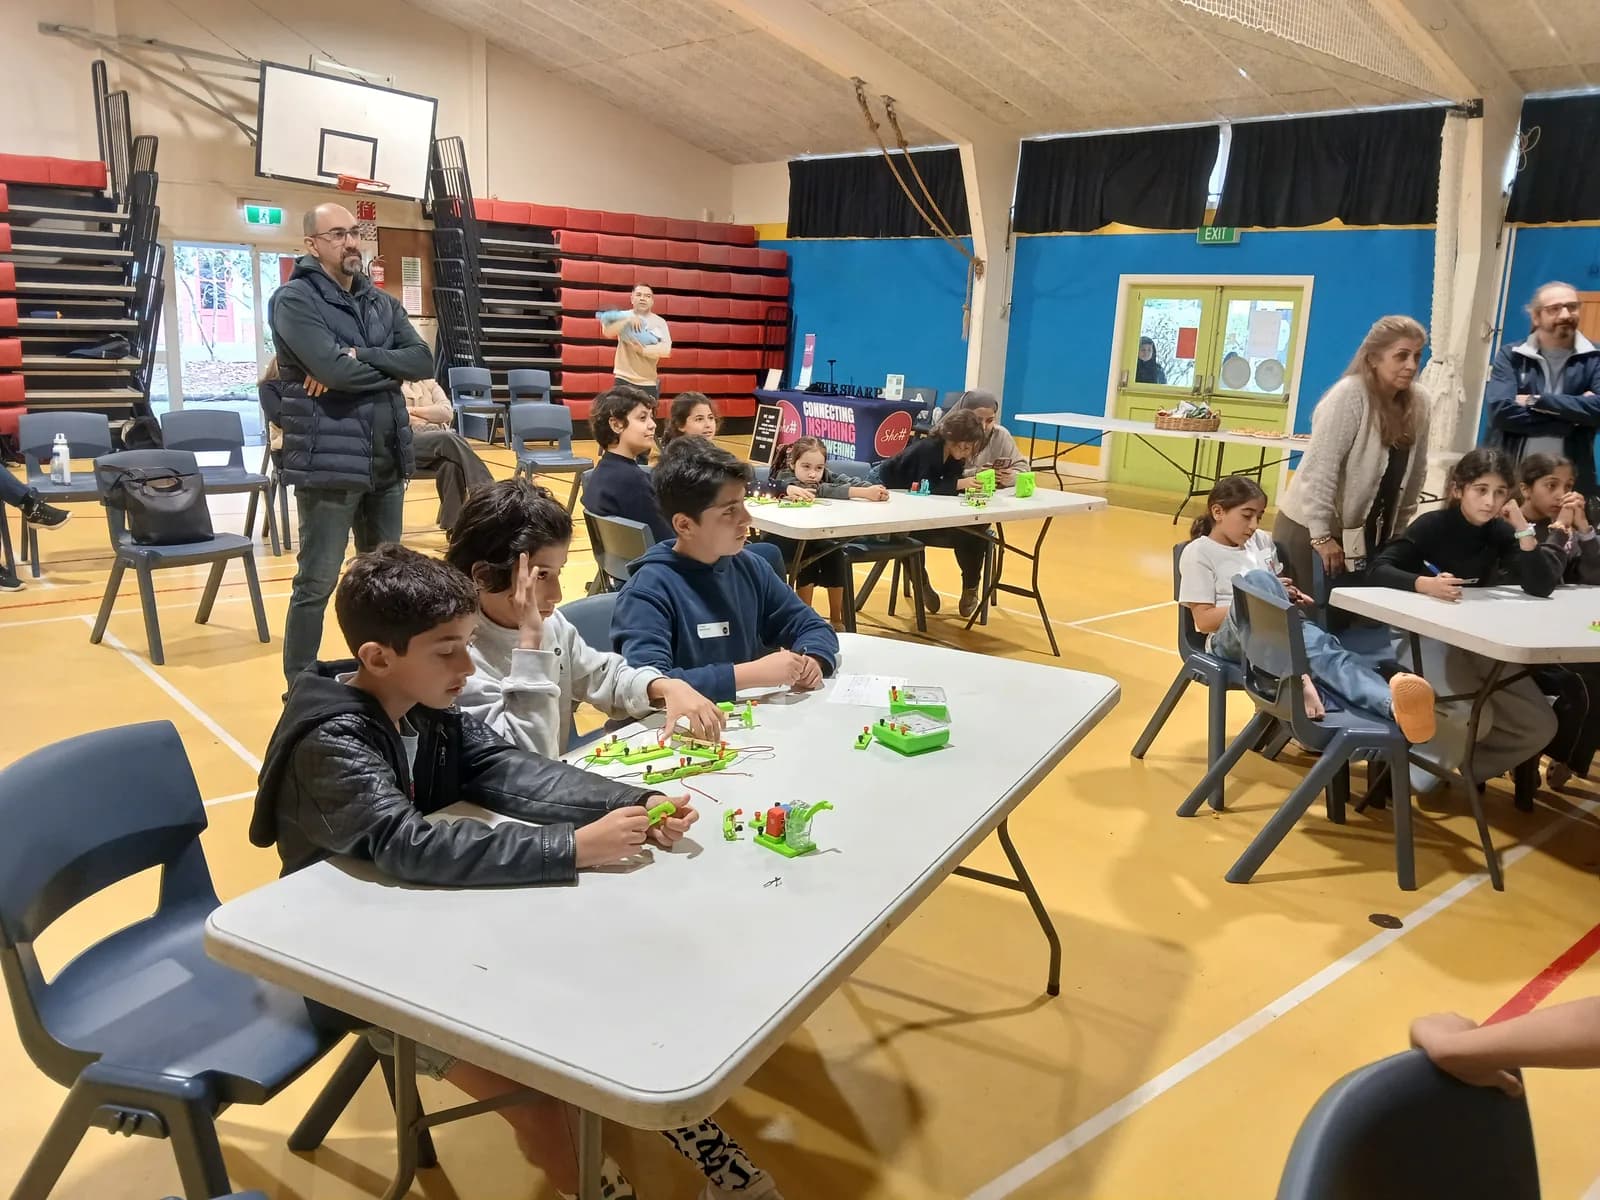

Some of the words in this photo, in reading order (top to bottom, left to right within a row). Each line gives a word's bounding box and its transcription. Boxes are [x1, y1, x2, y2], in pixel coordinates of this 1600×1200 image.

[1205, 227, 1227, 240] EXIT
[840, 384, 883, 399] SHARP
[803, 401, 854, 422] CONNECTING
[807, 417, 855, 443] INSPIRING
[881, 428, 907, 442] She#
[822, 438, 855, 459] WERING
